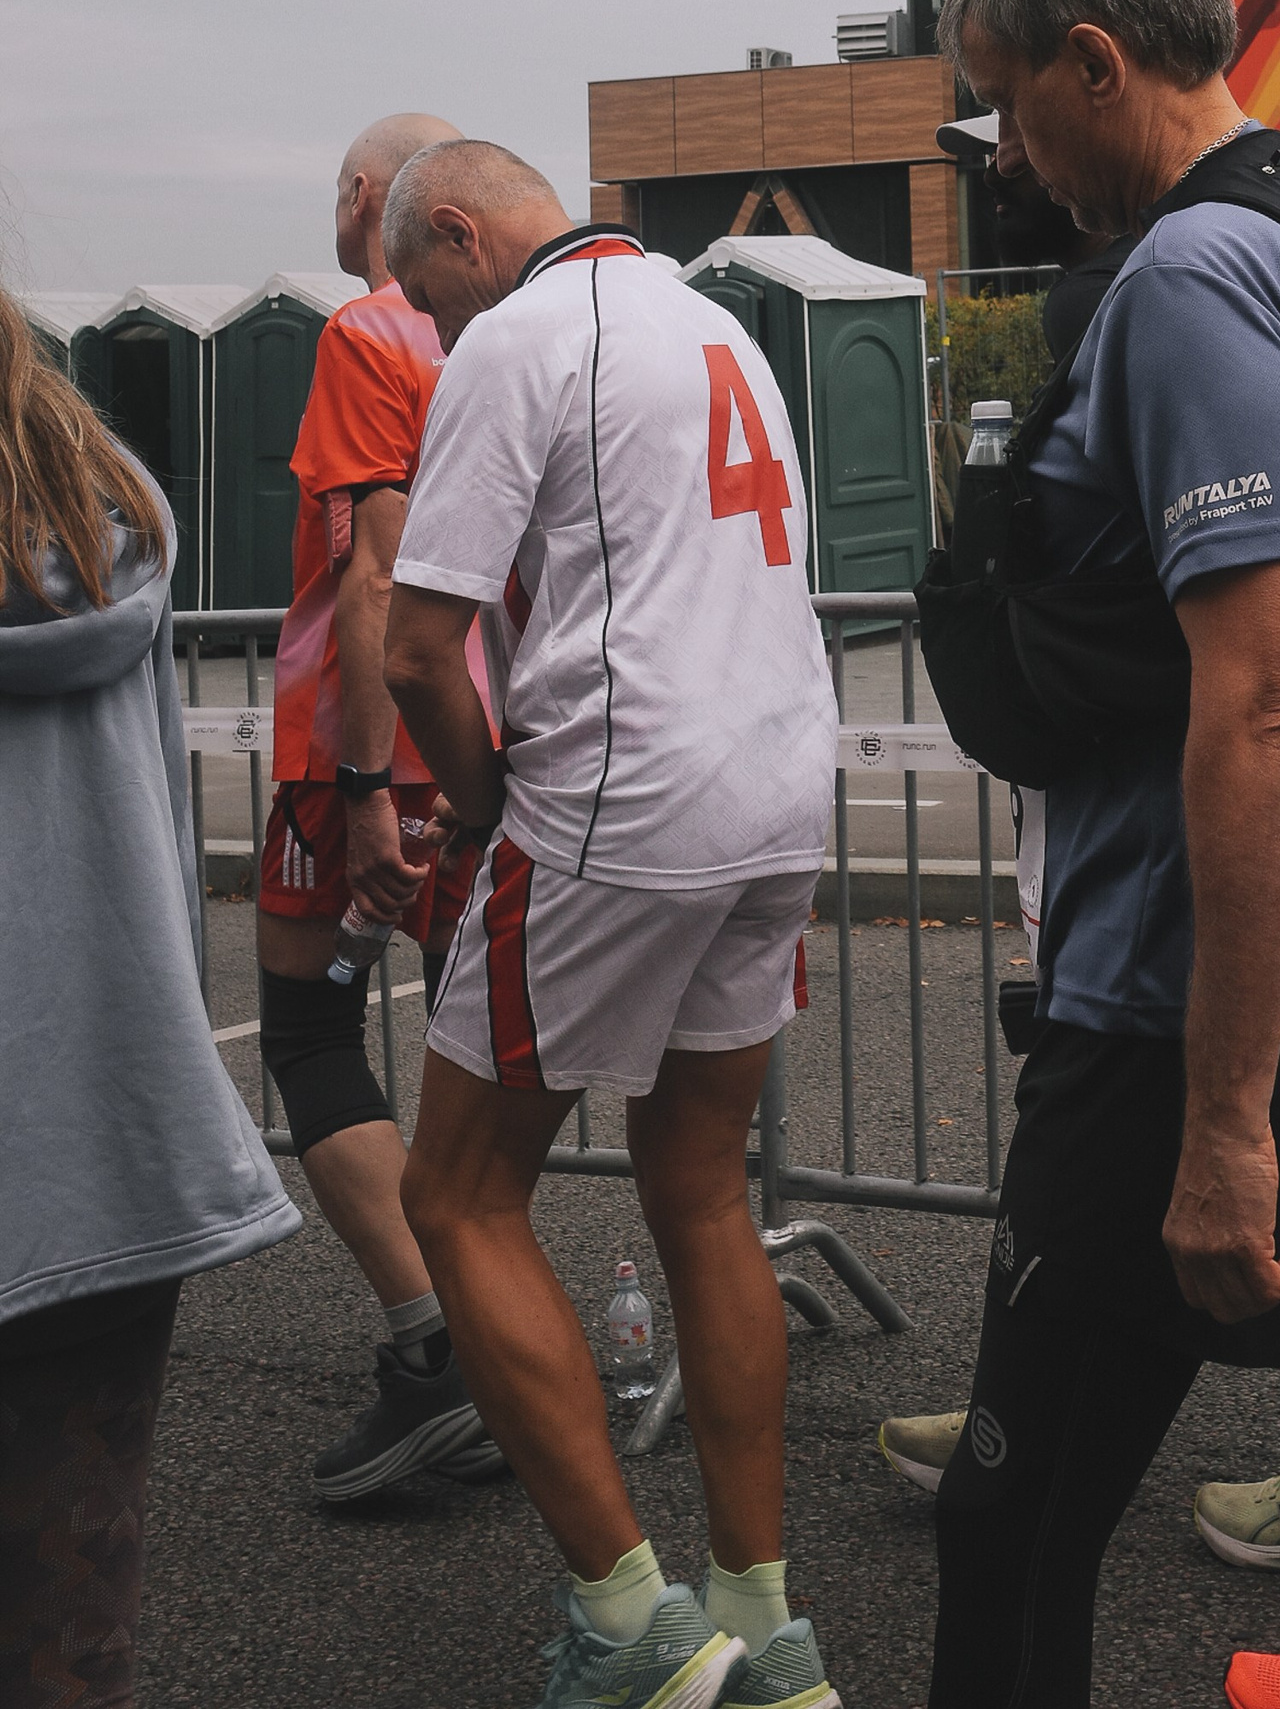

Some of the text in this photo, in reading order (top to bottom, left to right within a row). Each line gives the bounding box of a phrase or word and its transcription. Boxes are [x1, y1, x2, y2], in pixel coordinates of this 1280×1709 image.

[702, 344, 793, 567] 4
[1163, 471, 1272, 530] RUNTALYA
[1188, 516, 1199, 526] by
[1200, 501, 1248, 521] Fraport
[1248, 494, 1273, 509] TAV
[902, 742, 937, 751] runc.run
